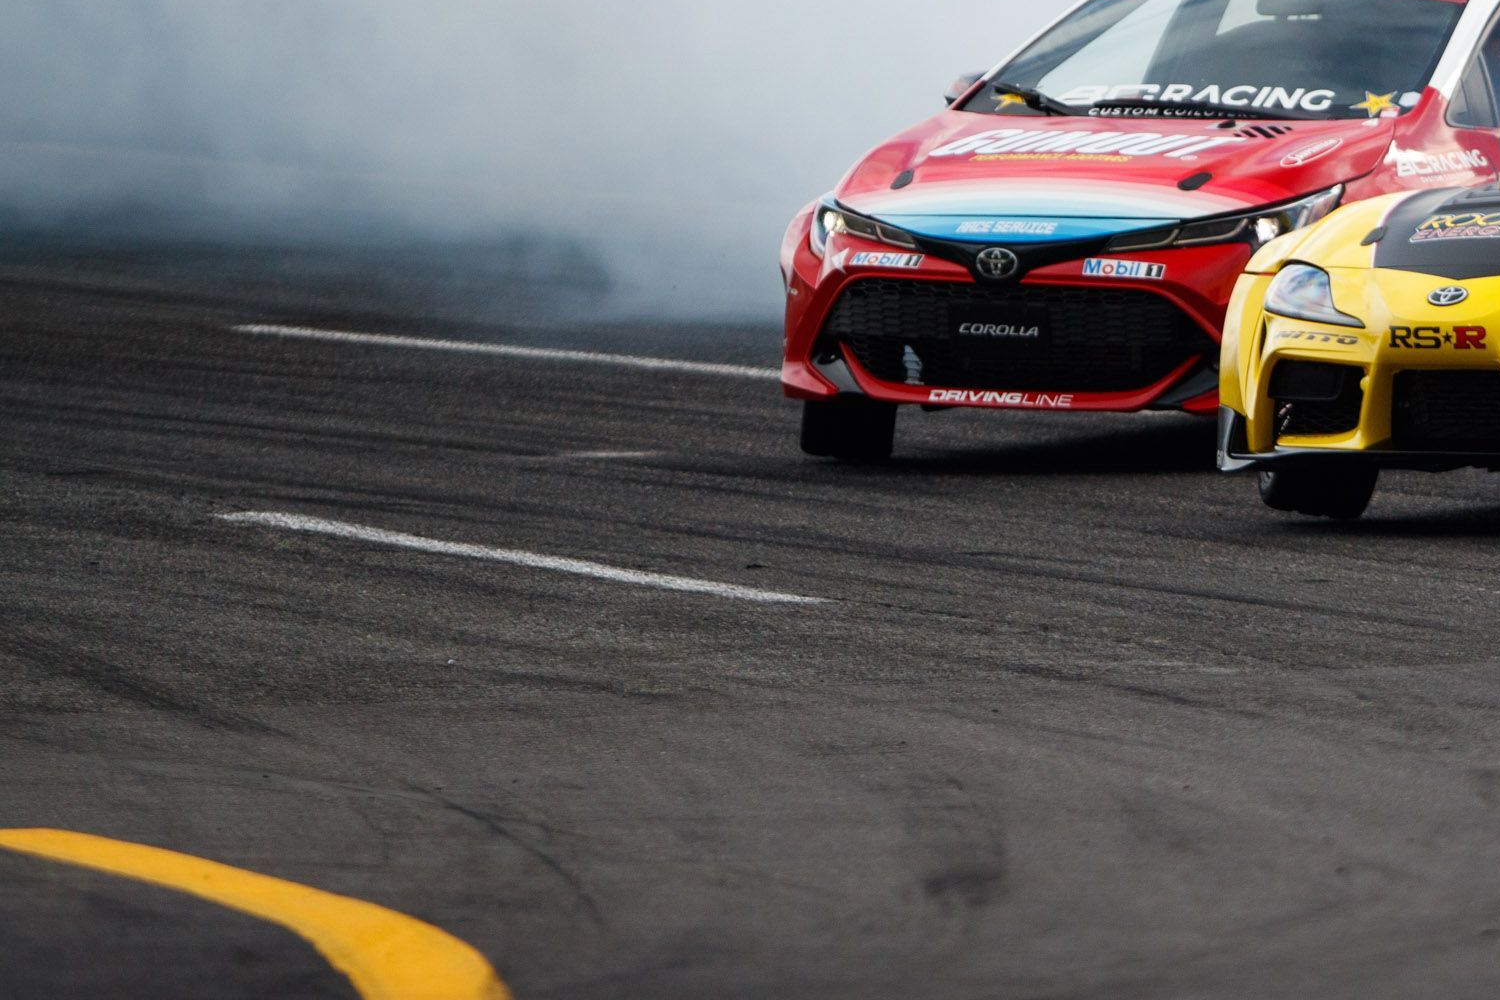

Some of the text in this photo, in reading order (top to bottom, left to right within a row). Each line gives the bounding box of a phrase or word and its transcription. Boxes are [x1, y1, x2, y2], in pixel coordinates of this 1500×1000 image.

[1160, 83, 1336, 112] RACING
[1088, 106, 1159, 117] CUSTOM
[929, 128, 1247, 158] GUMOUT
[1428, 148, 1488, 172] RACING
[851, 251, 900, 267] Mobil
[1083, 258, 1142, 277] Mobil
[958, 322, 1039, 337] COROLLA
[1276, 329, 1359, 346] NITTO
